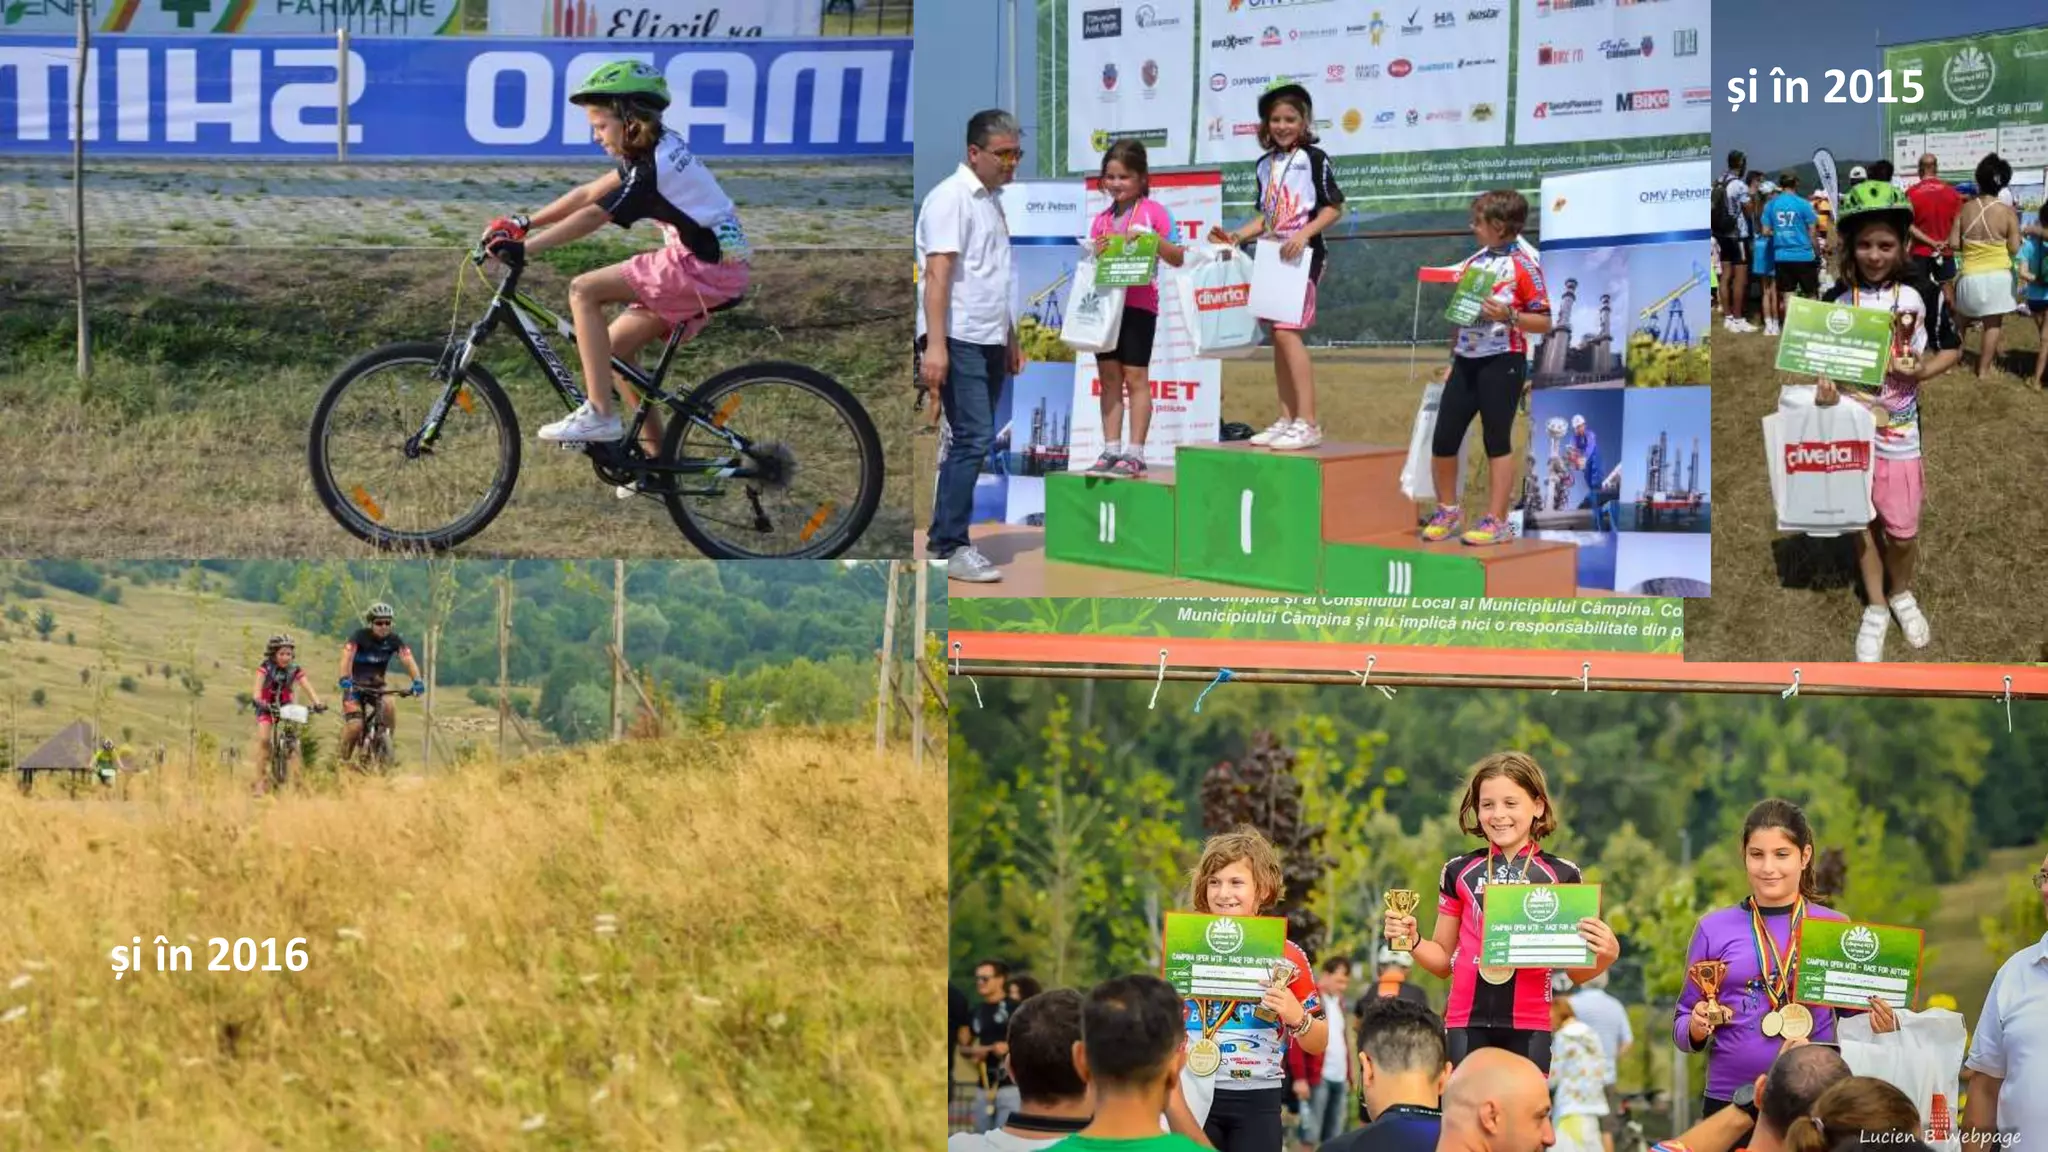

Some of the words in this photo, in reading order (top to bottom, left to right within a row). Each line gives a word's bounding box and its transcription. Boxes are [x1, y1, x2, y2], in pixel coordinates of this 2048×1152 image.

[1776, 210, 1796, 227] 57
[1786, 444, 1852, 467] diverta
[1099, 501, 1117, 544] II
[1388, 558, 1412, 596] III
[1411, 597, 1456, 610] Local
[1459, 598, 1473, 611] al
[1478, 599, 1577, 615] Municipiului
[1581, 600, 1655, 618] Câmpina.
[1177, 607, 1277, 624] Municipiului
[1281, 610, 1352, 629] Câmpina
[1355, 615, 1370, 632] și
[1374, 617, 1395, 628] nu
[1399, 615, 1457, 632] implică
[1461, 617, 1489, 631] nici
[1494, 622, 1505, 632] o
[1509, 621, 1638, 637] responsabilitate
[1642, 621, 1668, 638] din
